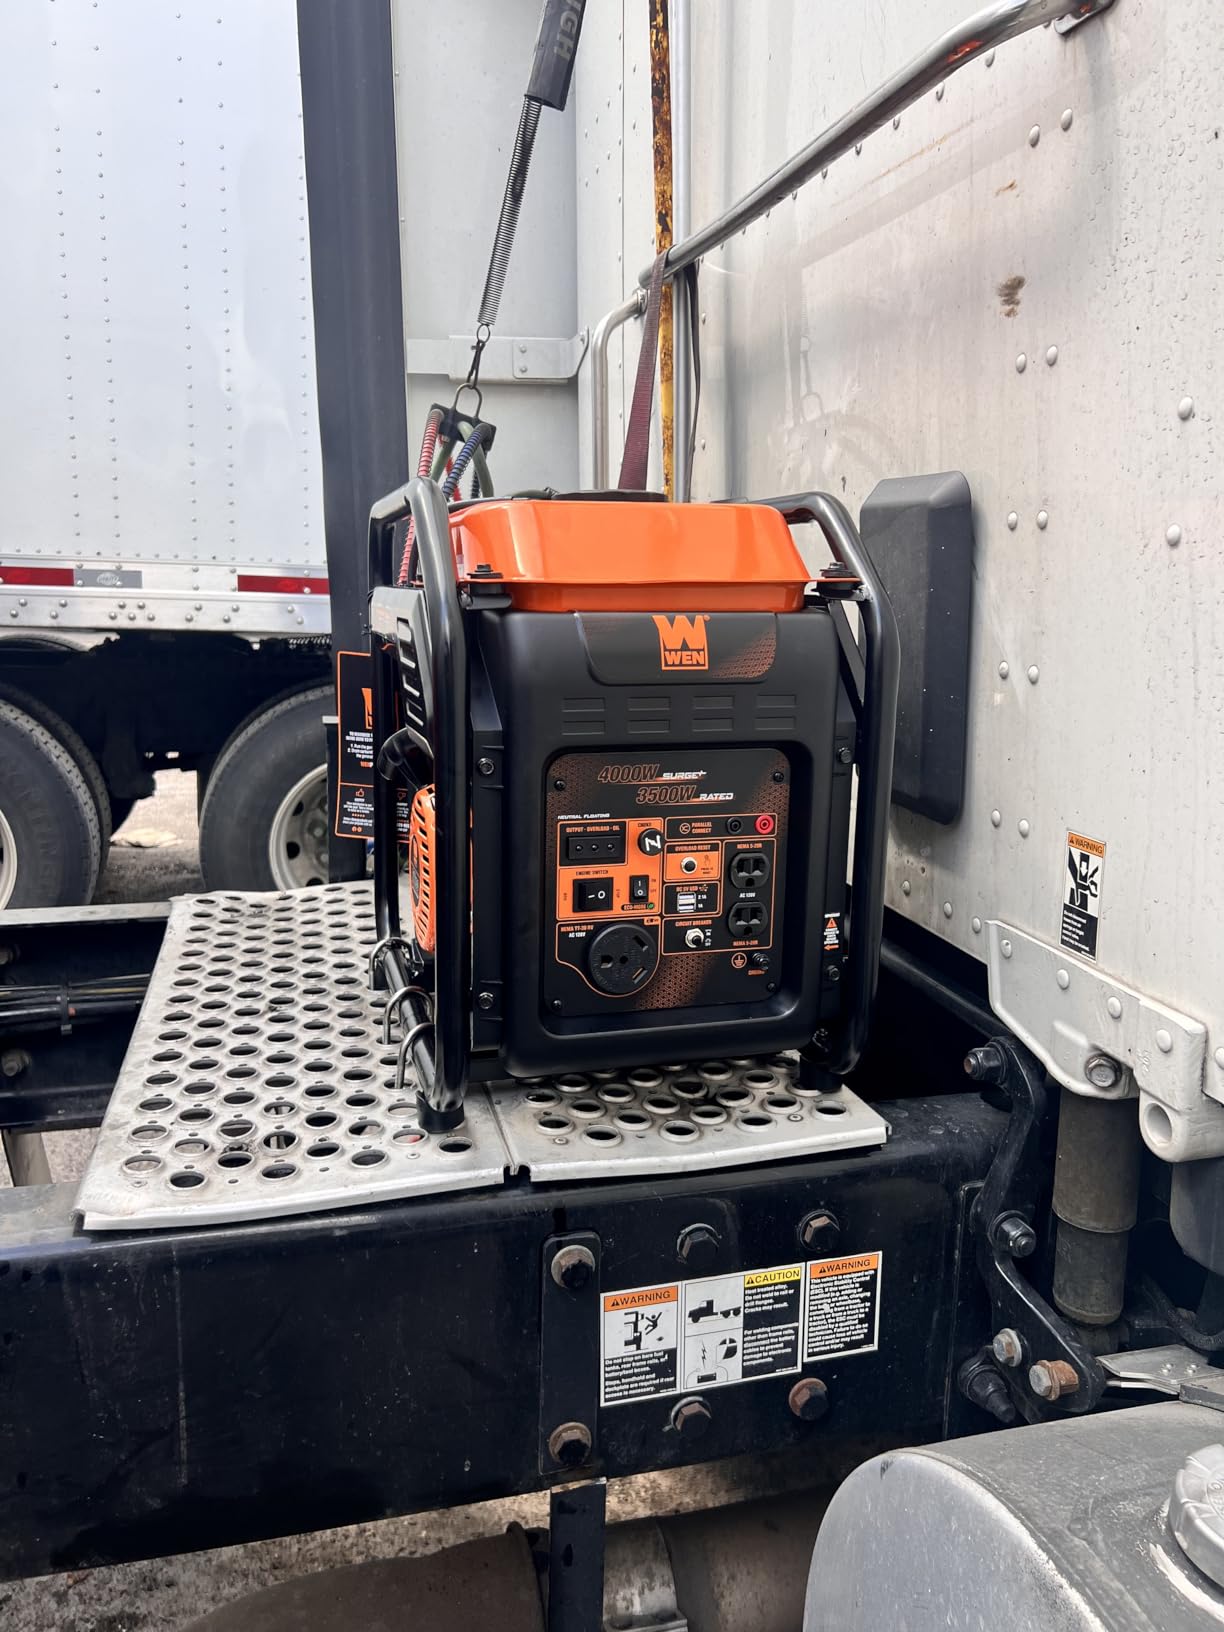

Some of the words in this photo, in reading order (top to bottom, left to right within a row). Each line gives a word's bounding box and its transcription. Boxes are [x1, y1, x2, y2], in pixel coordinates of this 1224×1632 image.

[664, 651, 704, 665] WEN
[598, 764, 659, 783] 4000W
[636, 785, 697, 804] 3500W
[699, 793, 734, 801] RATED
[1075, 838, 1102, 854] WARNING
[826, 1259, 871, 1273] WARNING
[755, 1270, 800, 1283] CAUTION
[620, 1290, 671, 1305] WARNING
